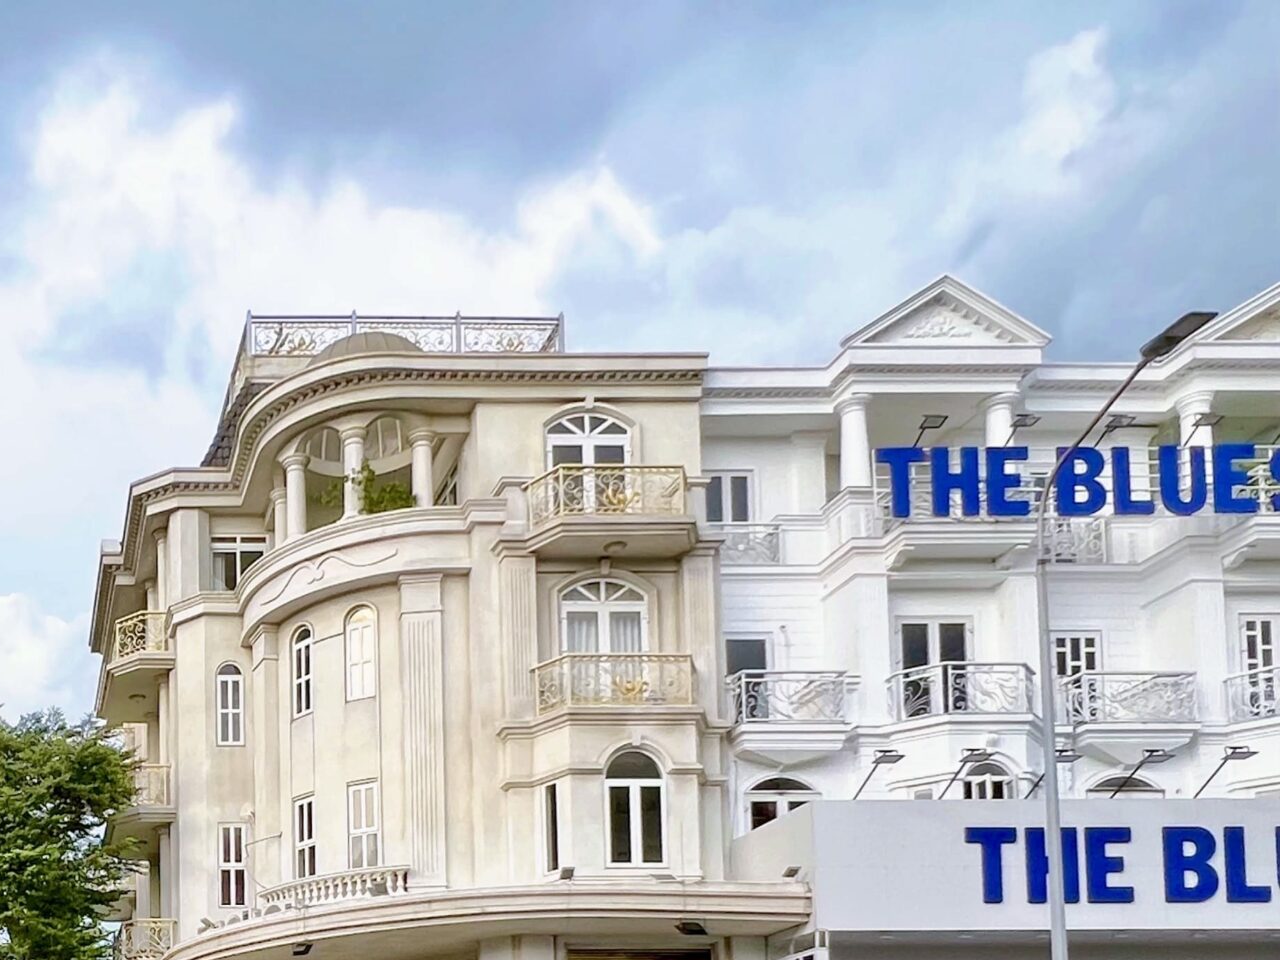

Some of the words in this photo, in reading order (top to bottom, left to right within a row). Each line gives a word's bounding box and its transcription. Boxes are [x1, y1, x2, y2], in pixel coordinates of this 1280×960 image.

[875, 446, 1031, 518] THE
[1055, 443, 1280, 517] BLUE
[964, 826, 1135, 904] THE
[1161, 826, 1280, 904] BL
